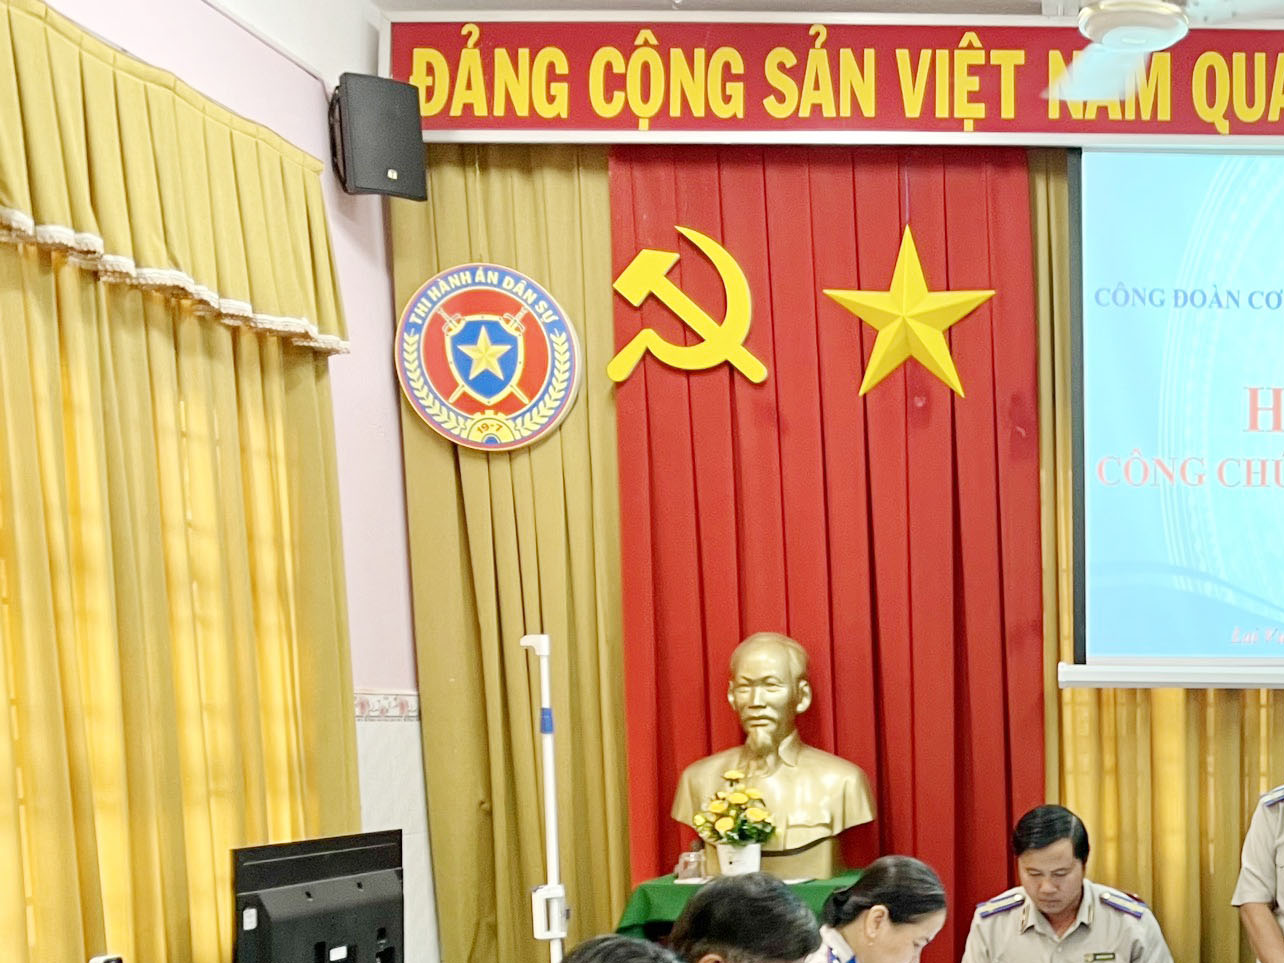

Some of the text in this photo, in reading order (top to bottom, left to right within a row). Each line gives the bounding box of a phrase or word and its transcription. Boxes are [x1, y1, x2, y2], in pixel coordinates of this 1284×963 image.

[411, 24, 568, 119] ĐẢNG
[589, 29, 745, 131] CỘNG
[762, 24, 876, 120] SẢN
[897, 31, 1025, 131] VIỆT
[409, 266, 559, 325] THI HÀNH ÁN DÂN SỰ
[1094, 281, 1166, 309] CÔNG
[1173, 284, 1240, 309] ĐOÀN
[1248, 288, 1283, 310] CƠ
[1097, 448, 1205, 487] CÔNG
[1231, 626, 1258, 645] Lai
